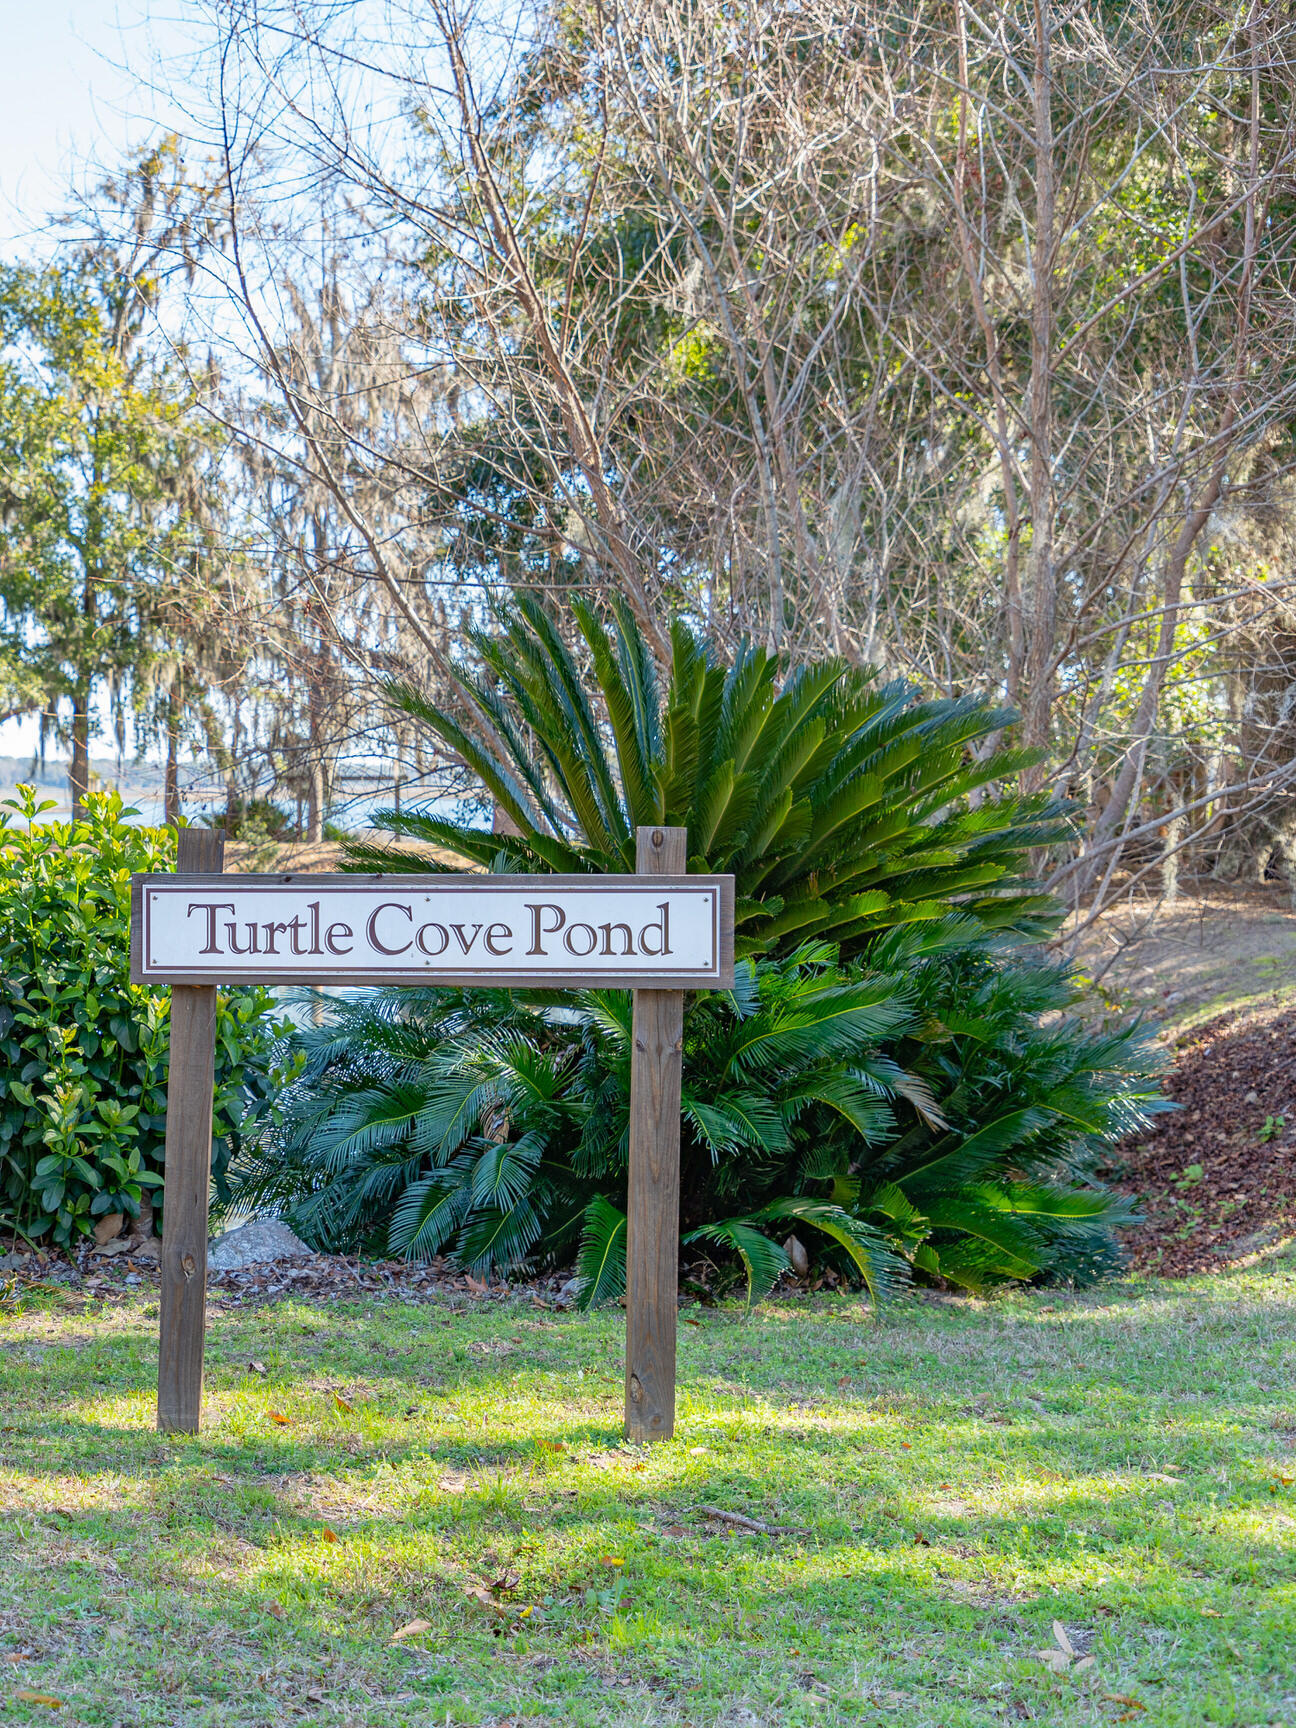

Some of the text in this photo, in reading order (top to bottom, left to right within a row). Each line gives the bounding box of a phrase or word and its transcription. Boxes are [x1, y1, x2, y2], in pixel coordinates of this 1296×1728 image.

[187, 901, 673, 956] Turtle Cove Pond
